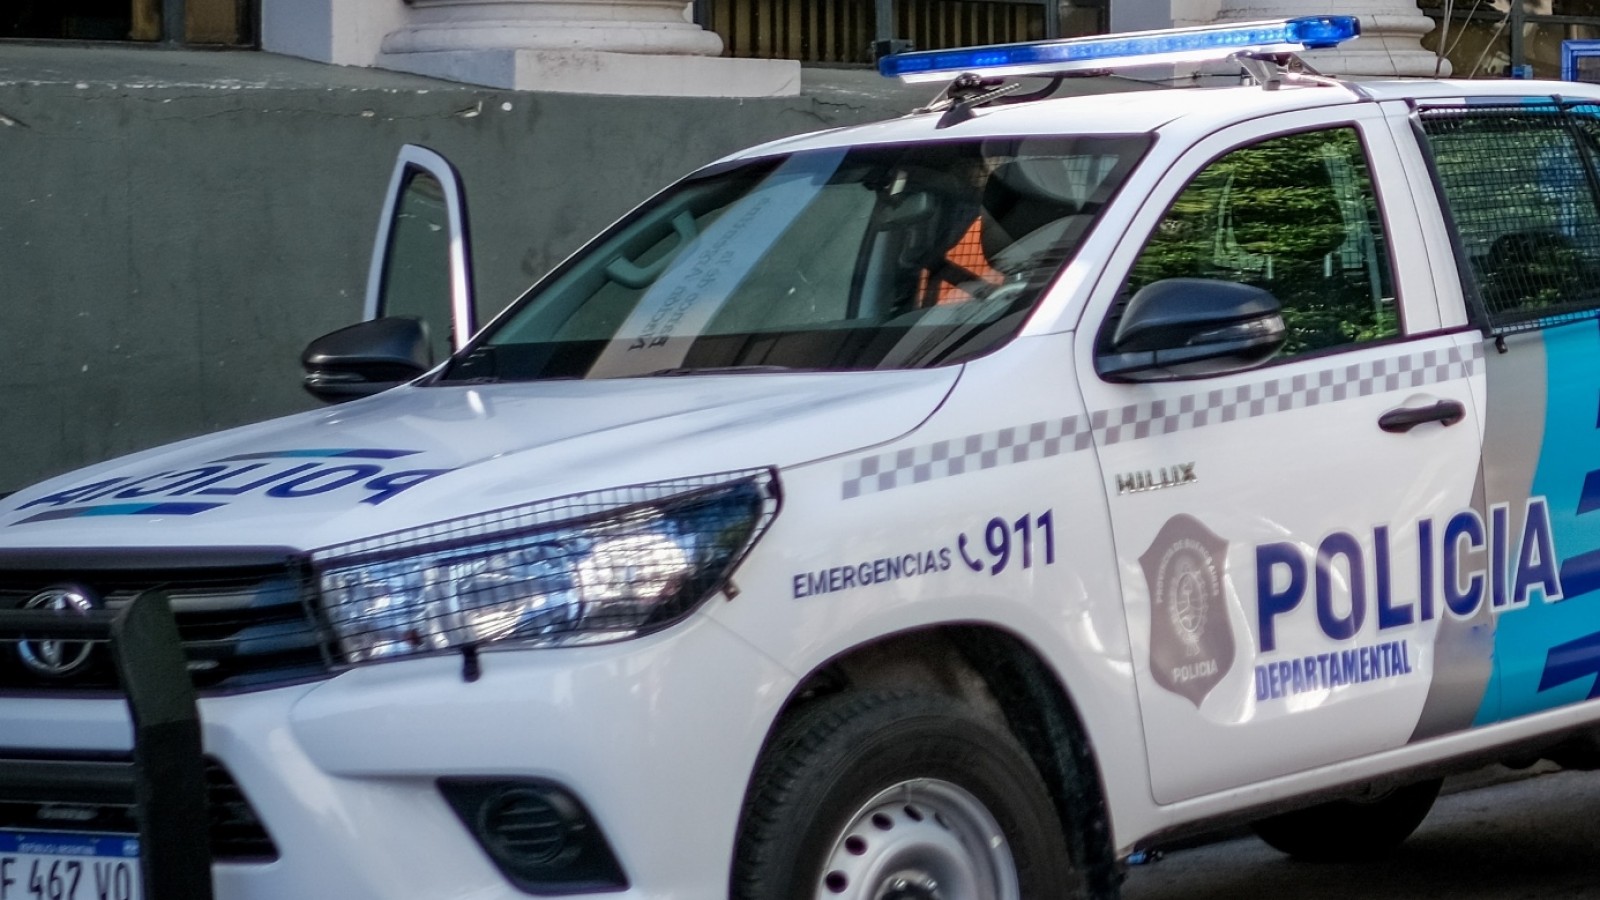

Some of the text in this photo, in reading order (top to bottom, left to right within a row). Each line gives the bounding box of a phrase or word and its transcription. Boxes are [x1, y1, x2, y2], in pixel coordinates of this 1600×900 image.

[1115, 461, 1198, 495] HILUX
[792, 508, 1056, 600] EMERGENCIAS 911
[1254, 497, 1562, 654] POLICIA
[1173, 658, 1219, 683] POLICIA
[1254, 640, 1412, 702] DEPARTAMENTAL
